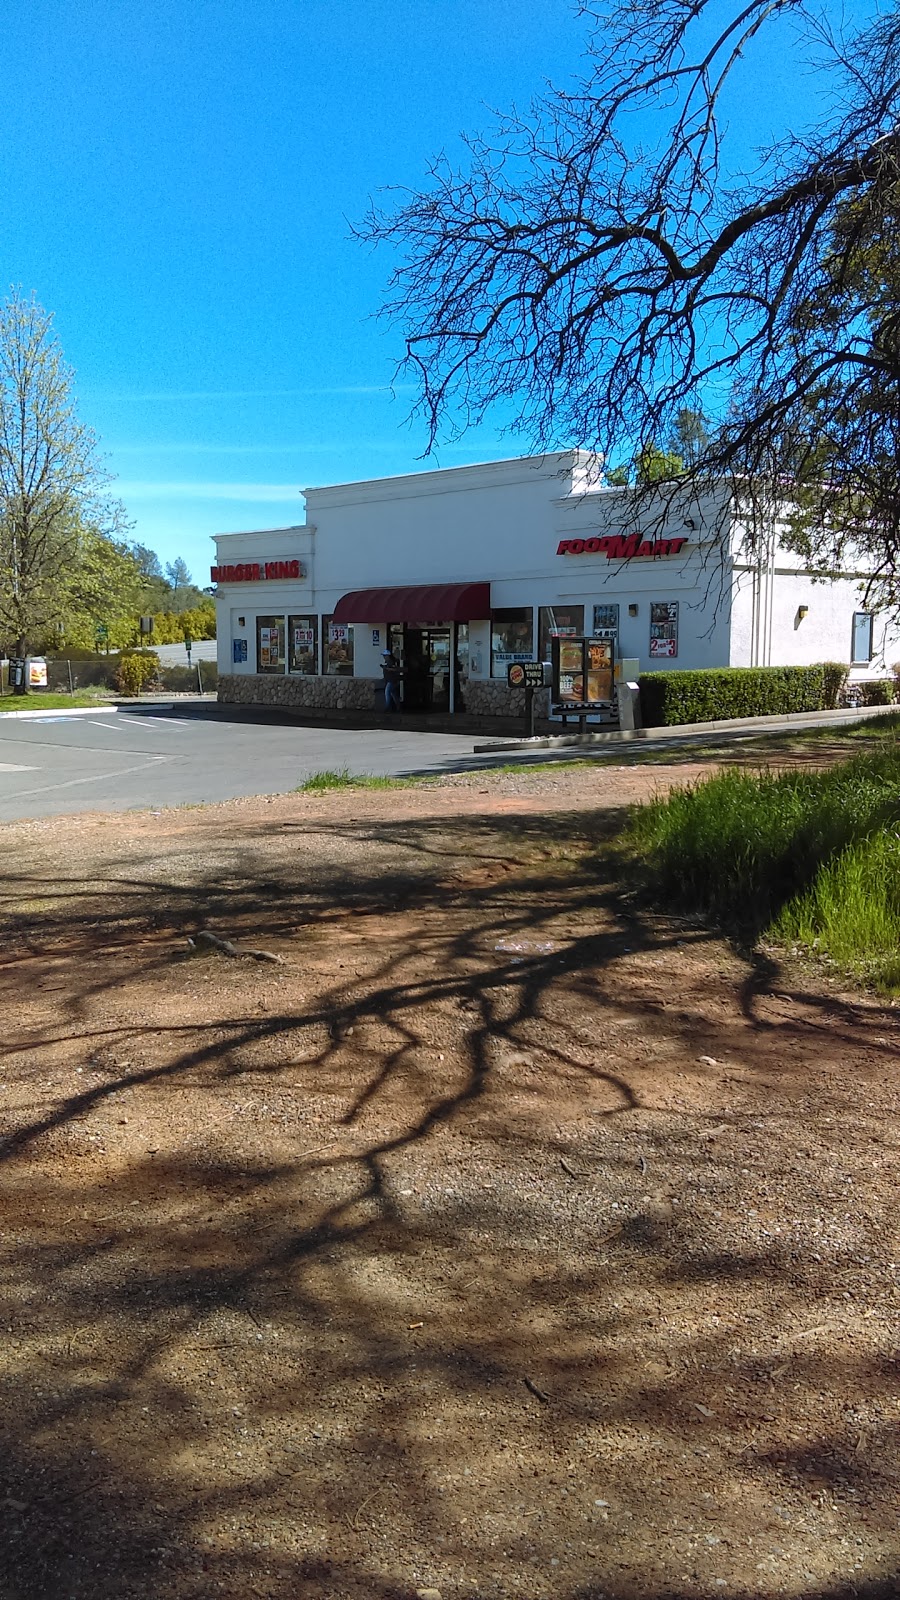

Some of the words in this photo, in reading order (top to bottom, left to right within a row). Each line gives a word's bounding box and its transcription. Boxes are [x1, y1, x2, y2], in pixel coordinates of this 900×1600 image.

[210, 563, 260, 583] BURGER
[264, 559, 300, 579] KING
[651, 639, 658, 651] 2
